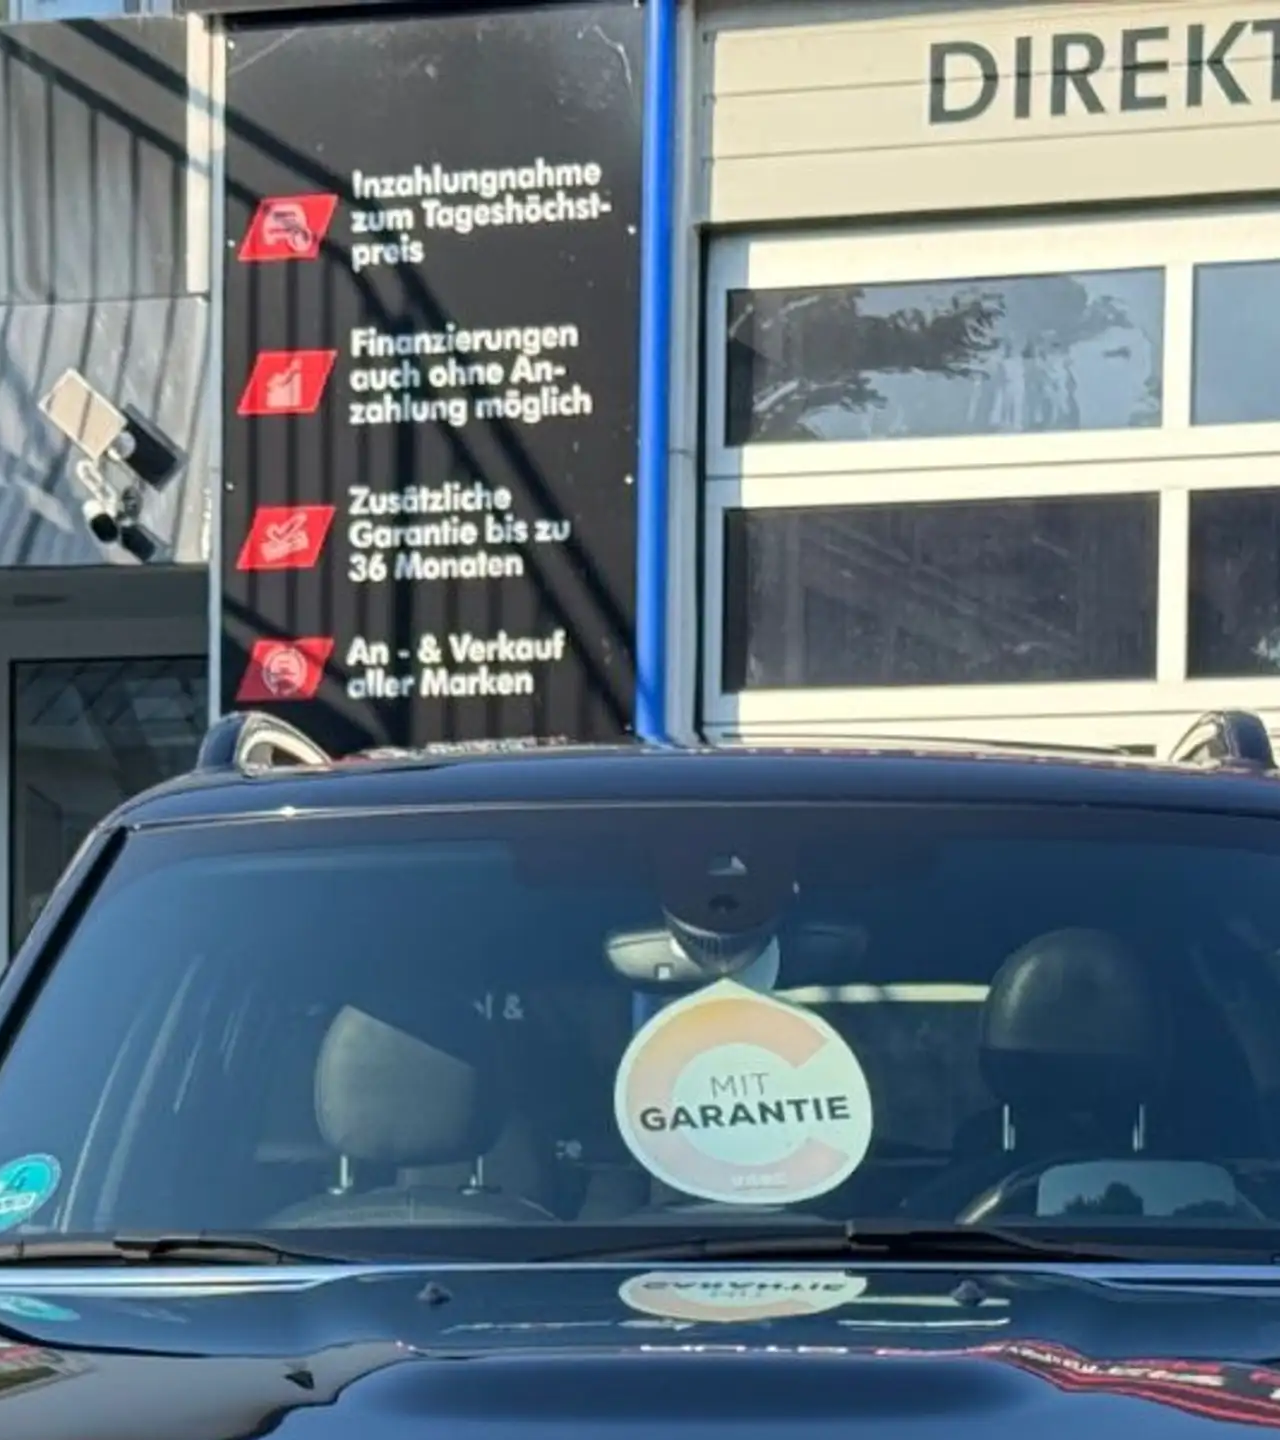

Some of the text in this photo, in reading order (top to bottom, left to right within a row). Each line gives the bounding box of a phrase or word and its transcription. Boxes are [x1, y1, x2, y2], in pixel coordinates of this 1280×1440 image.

[352, 158, 602, 200] Inzahlungnahme
[351, 191, 612, 235] zum Tageshöchst-
[351, 234, 424, 272] preis
[351, 323, 578, 358] Finanzierungen
[350, 355, 566, 391] auch ohne An-
[349, 387, 592, 427] zahlung möglich
[348, 482, 511, 515] Zusätzliche
[348, 515, 571, 548] Garantie bis zu
[348, 548, 524, 582] 36 Monaten
[346, 637, 389, 666] An
[418, 635, 442, 664] &
[448, 630, 565, 664] Verkauf
[347, 668, 534, 699] aller Marken
[709, 1072, 770, 1098] MIT
[640, 1094, 851, 1131] GARANTIE
